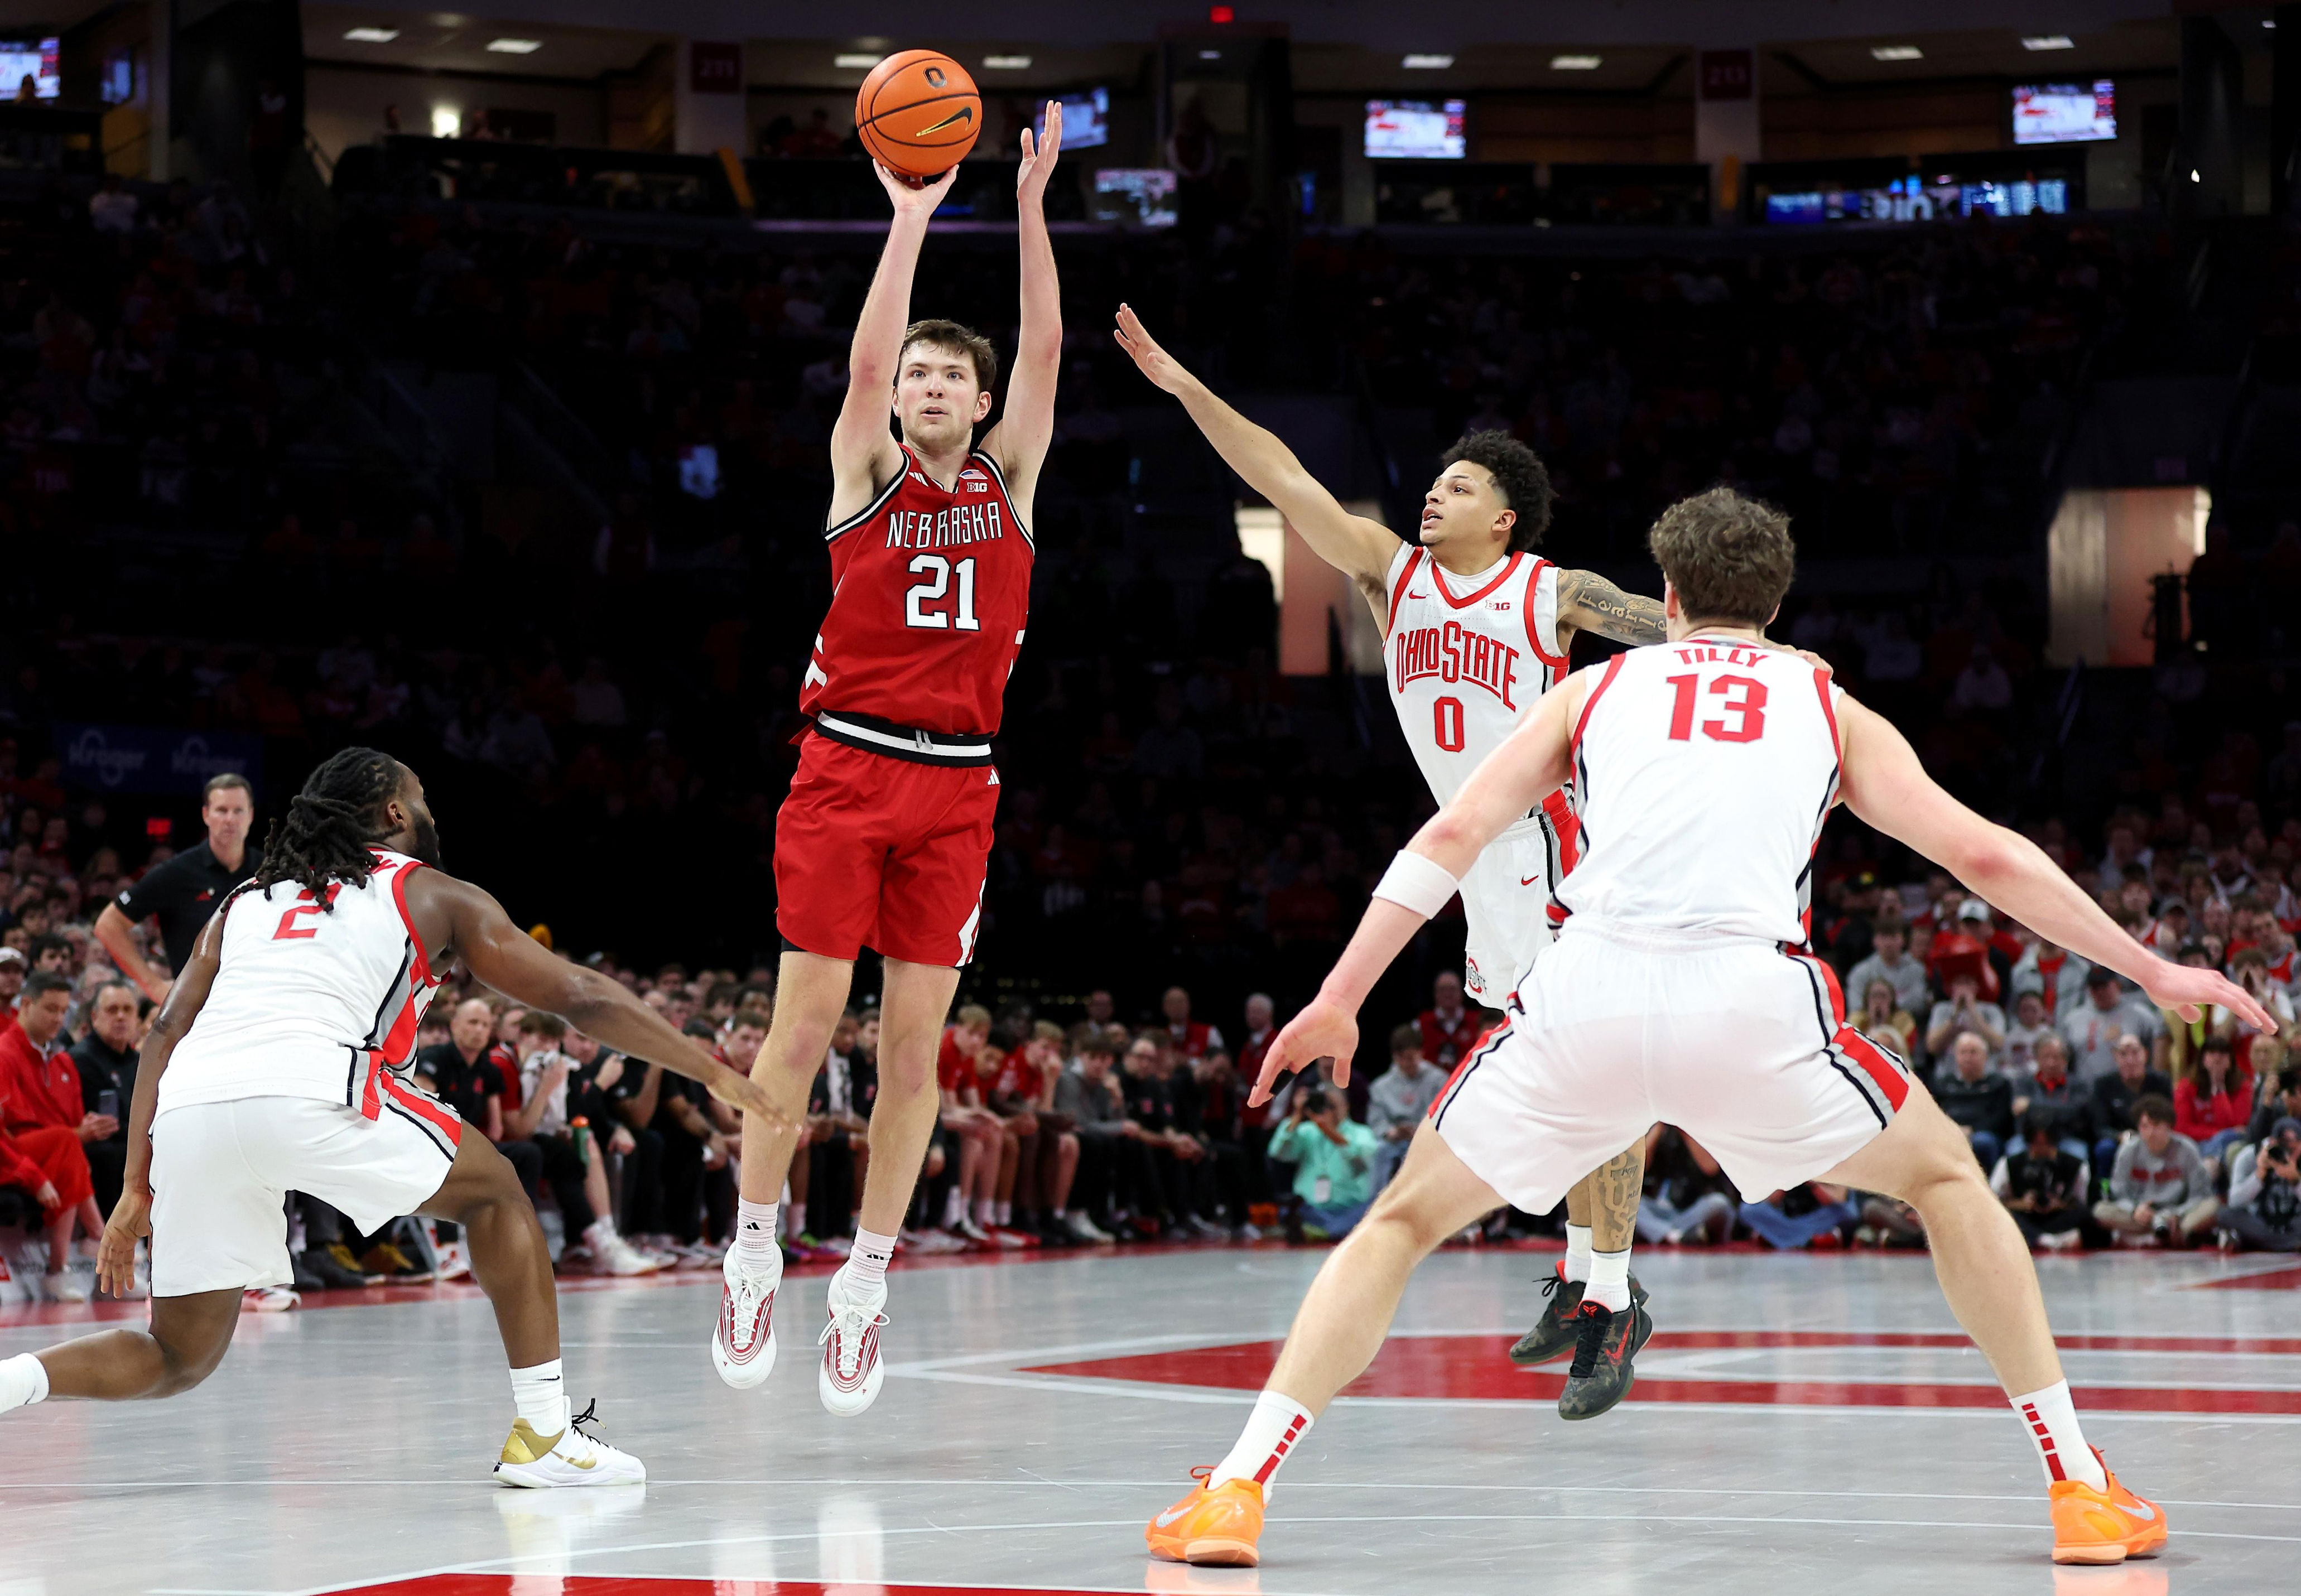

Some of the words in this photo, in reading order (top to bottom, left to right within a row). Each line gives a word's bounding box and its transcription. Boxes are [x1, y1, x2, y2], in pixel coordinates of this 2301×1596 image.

[885, 501, 1003, 549] NEBRASKA
[905, 553, 980, 631] 21
[1673, 648, 1770, 668] TILLY
[1434, 696, 1465, 753] 0
[1665, 673, 1768, 744] 13
[272, 881, 343, 941] 2
